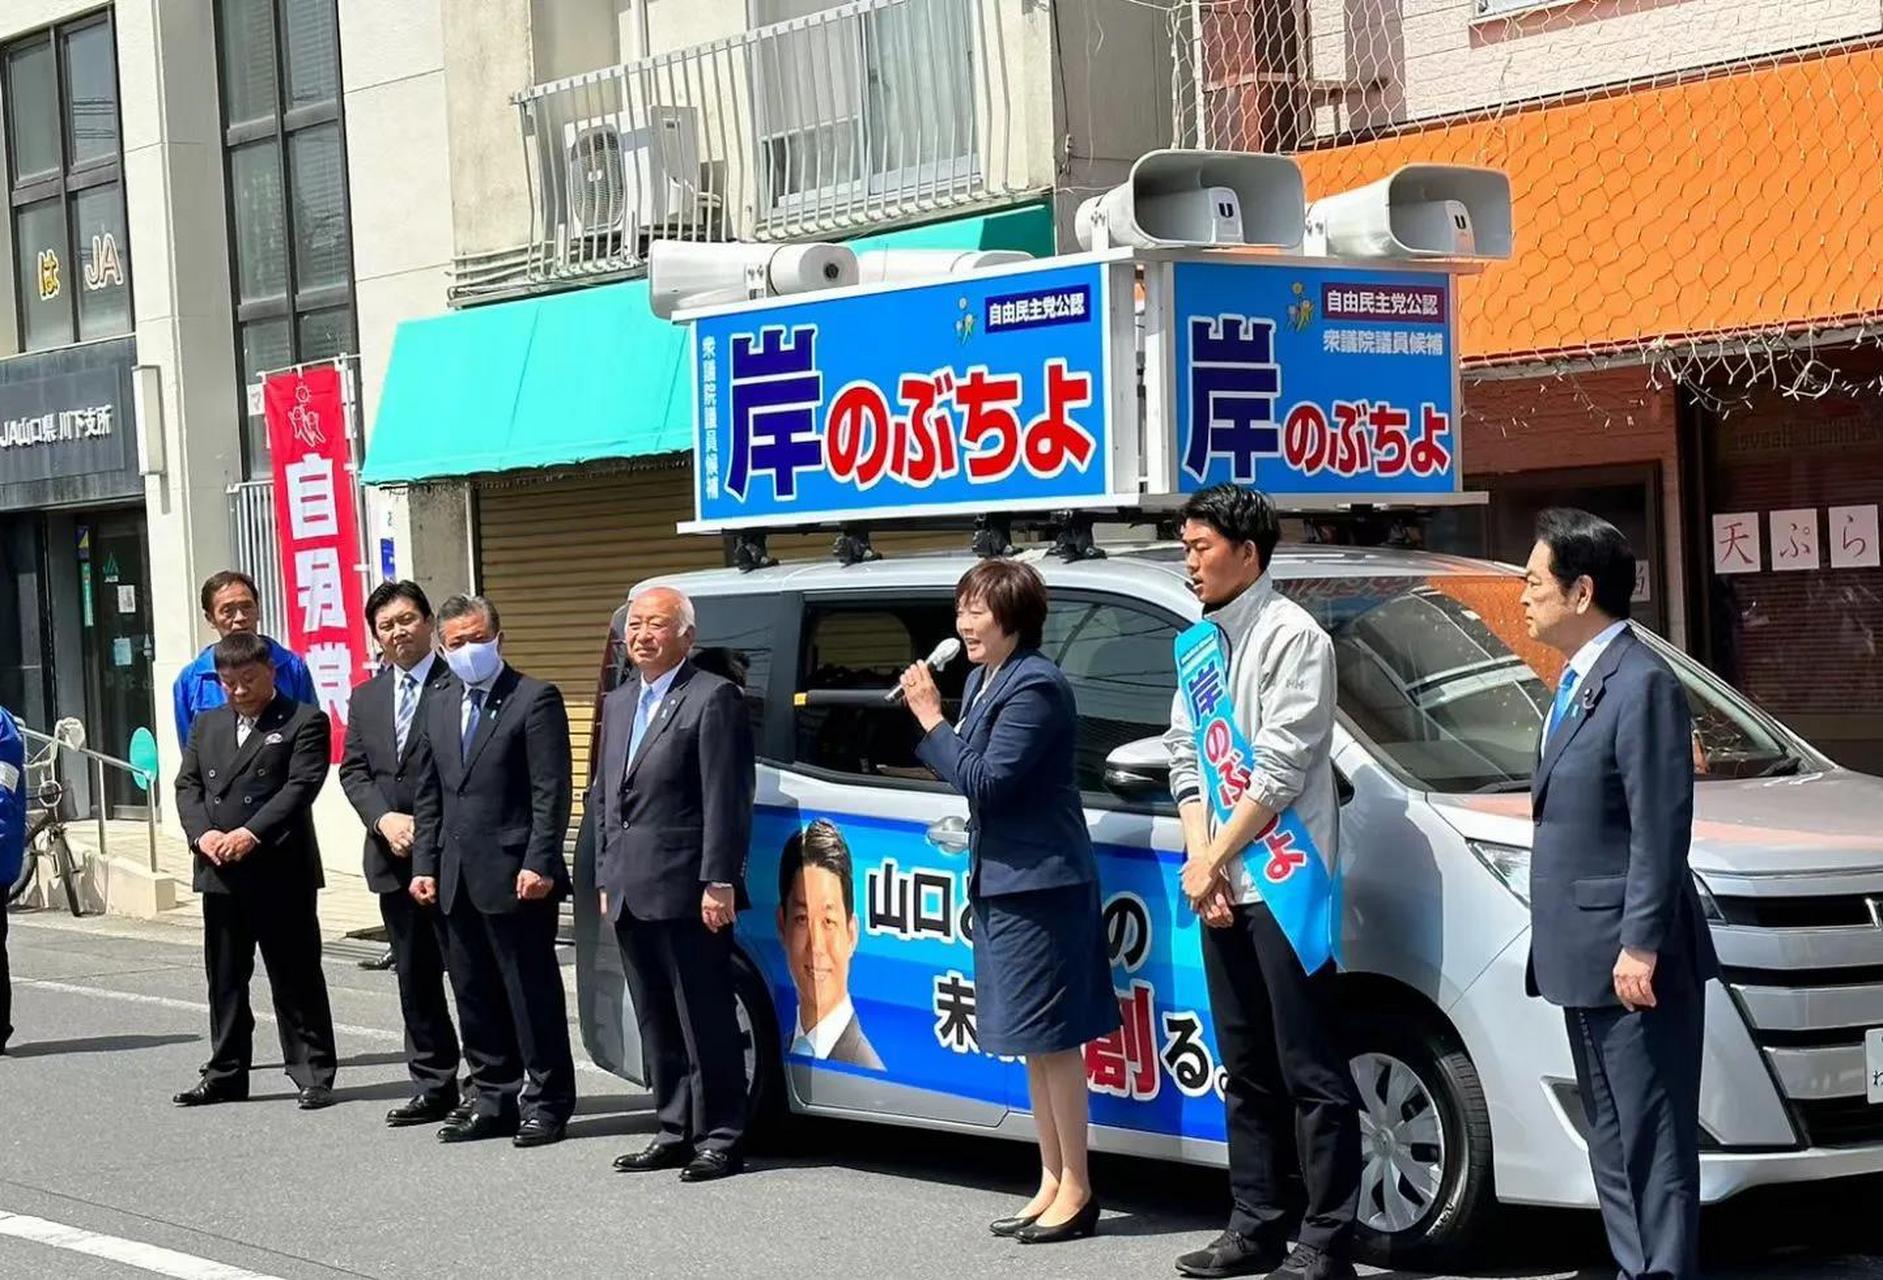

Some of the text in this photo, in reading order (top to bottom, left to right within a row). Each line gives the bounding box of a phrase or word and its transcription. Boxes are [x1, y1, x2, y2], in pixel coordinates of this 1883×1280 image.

[85, 233, 123, 290] JA
[989, 292, 1085, 326] 自由民主党公認
[1327, 289, 1438, 315] 自由民主党公認
[1322, 328, 1443, 355] 衆議院議員候補
[726, 326, 1094, 499] 岸のぶちよ
[1184, 316, 1451, 481] 岸のぶちよ
[1718, 513, 1867, 566] 天ぷら
